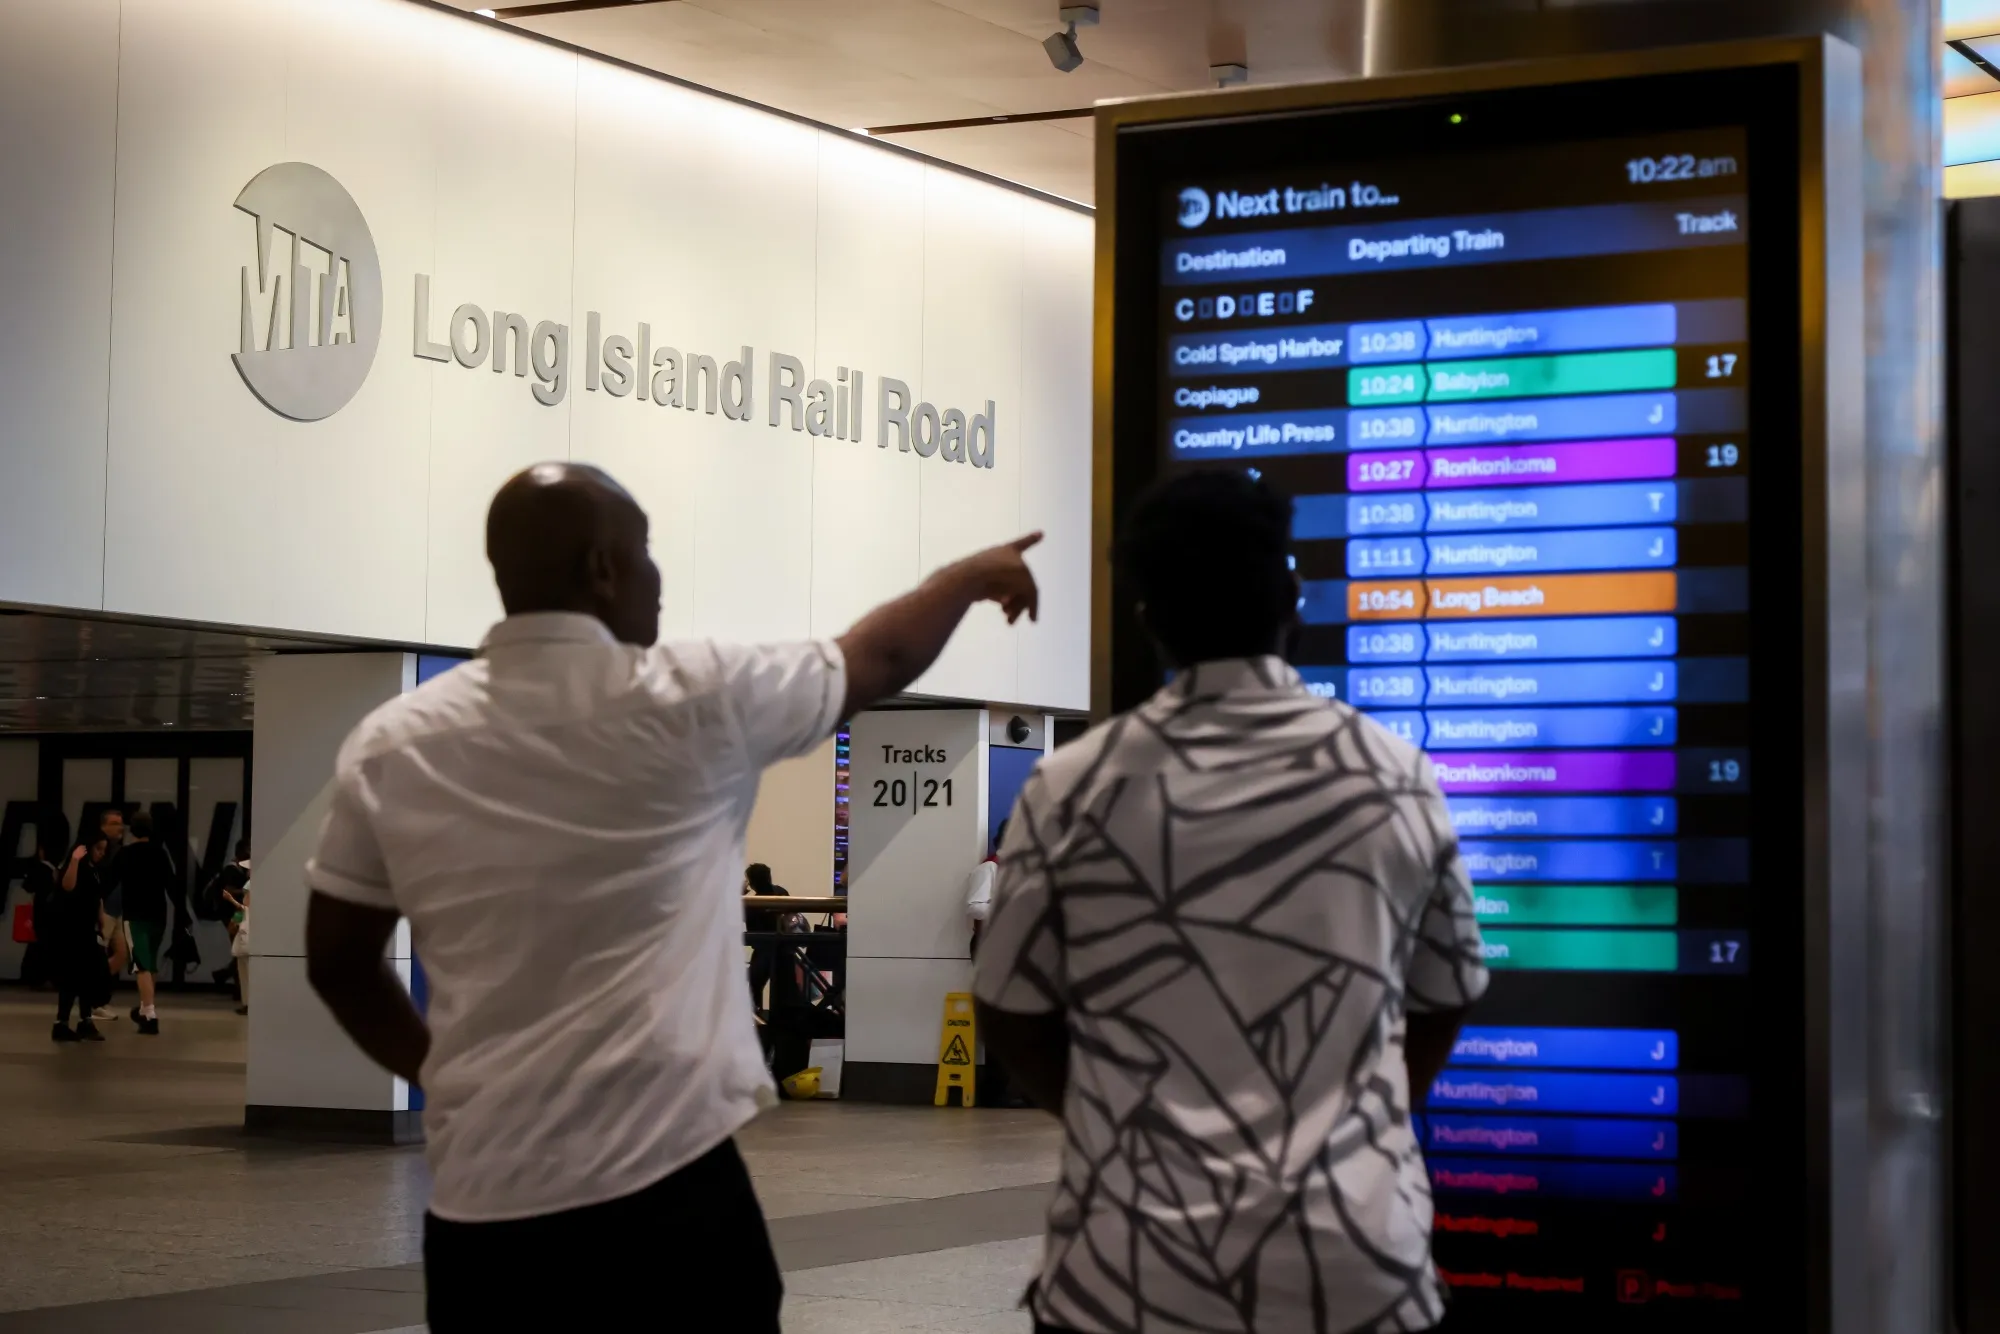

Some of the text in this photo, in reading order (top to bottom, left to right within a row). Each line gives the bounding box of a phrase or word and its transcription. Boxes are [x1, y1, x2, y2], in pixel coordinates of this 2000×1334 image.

[1216, 189, 1280, 219] Next
[1284, 183, 1346, 213] train
[1176, 210, 1738, 273] Destination Departing Train Track
[1175, 289, 1314, 321] C D E F
[1176, 323, 1538, 365] Cold Spring Harbor 10:38 Huntington
[413, 273, 996, 469] Long Island Rail Road
[1175, 355, 1738, 409] Copiague 10:24 Babylon 17
[1175, 405, 1664, 450] Country Life Press 10:38 Huntington J
[1359, 445, 1739, 483] 10:27 Ronkonkoma 19
[1359, 504, 1415, 525] 10:38
[1433, 500, 1538, 525] Huntington
[1359, 537, 1664, 568] 11:11 Huntington J
[1358, 585, 1544, 612] 10:54 Long Beach
[1359, 626, 1664, 658] 10:38 Huntington J
[1359, 679, 1415, 698] 10:38
[1433, 677, 1538, 702] Huntington
[1648, 672, 1664, 692] J
[1433, 718, 1538, 743] Huntington
[1650, 717, 1664, 737] J
[881, 744, 946, 764] Tracks
[1709, 760, 1740, 781] 19
[873, 778, 954, 807] 20 21
[1650, 807, 1664, 827] J
[1710, 941, 1740, 963] 17
[1650, 1040, 1665, 1060] J
[1433, 1081, 1664, 1105] Huntington J
